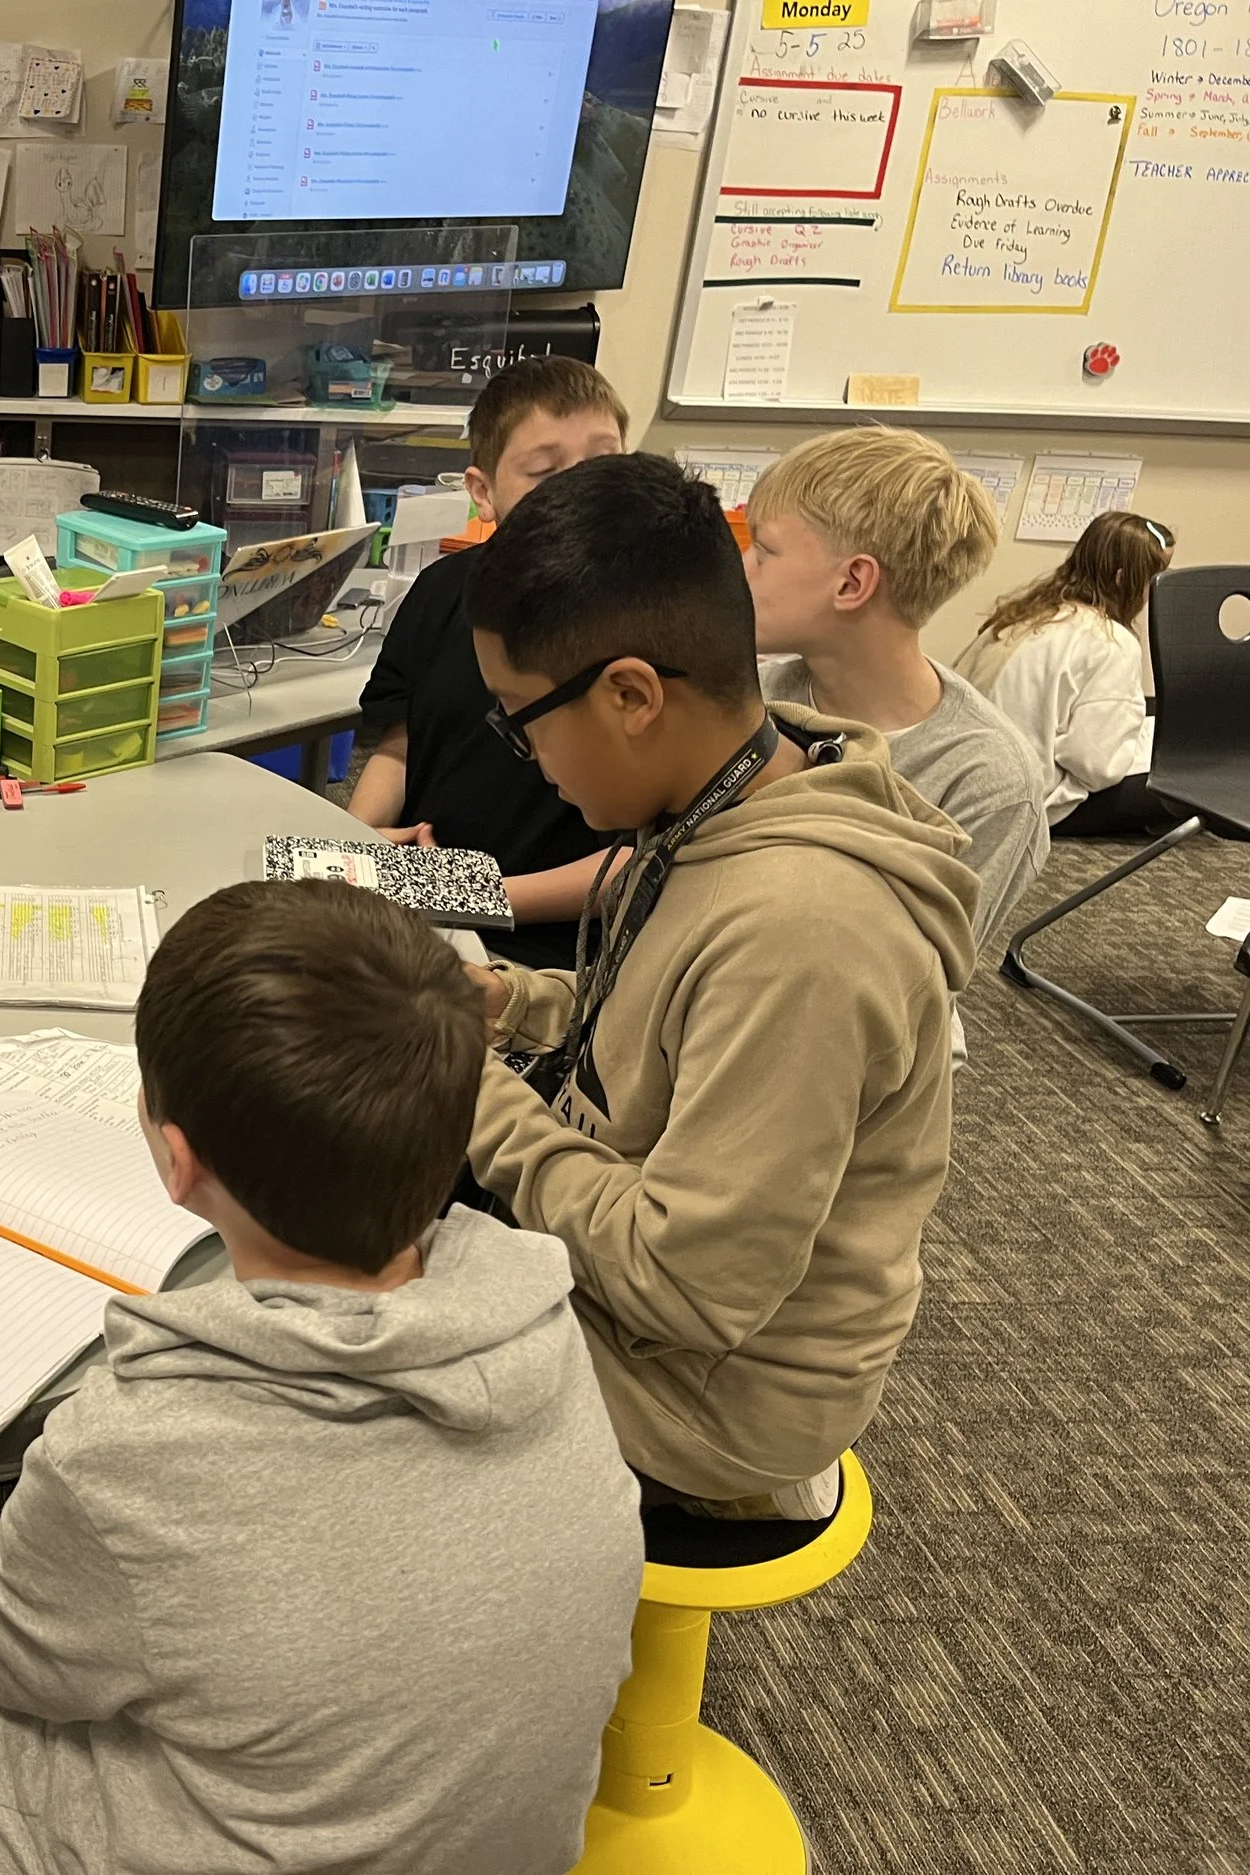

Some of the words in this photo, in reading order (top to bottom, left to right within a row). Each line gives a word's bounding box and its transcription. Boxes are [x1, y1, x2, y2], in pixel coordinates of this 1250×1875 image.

[781, 2, 852, 21] Monday
[1154, 0, 1228, 26] Oregon
[827, 65, 848, 82] due
[1151, 69, 1193, 84] Winter
[1146, 88, 1182, 105] Spring
[751, 108, 767, 119] no
[778, 110, 820, 121] cursive
[833, 109, 855, 122] this
[938, 97, 996, 120] Bellwork
[1140, 107, 1188, 119] Summer
[1138, 122, 1158, 137] Fall
[925, 168, 1008, 189] Assignments
[1129, 160, 1193, 179] TEACHER
[995, 193, 1036, 209] Drafts
[1045, 199, 1093, 216] Overdue
[731, 224, 771, 235] Cursive
[950, 213, 997, 231] Evidence
[1003, 219, 1017, 234] of
[1026, 221, 1071, 245] Learning
[963, 234, 985, 249] Due
[995, 238, 1027, 265] Friday
[770, 254, 807, 267] Drafts
[942, 253, 991, 277] Return
[1003, 263, 1043, 294] library
[1054, 267, 1088, 289] books
[667, 826, 686, 851] ARMY
[686, 786, 725, 829] NATIONAL
[723, 758, 752, 789] GUARD
